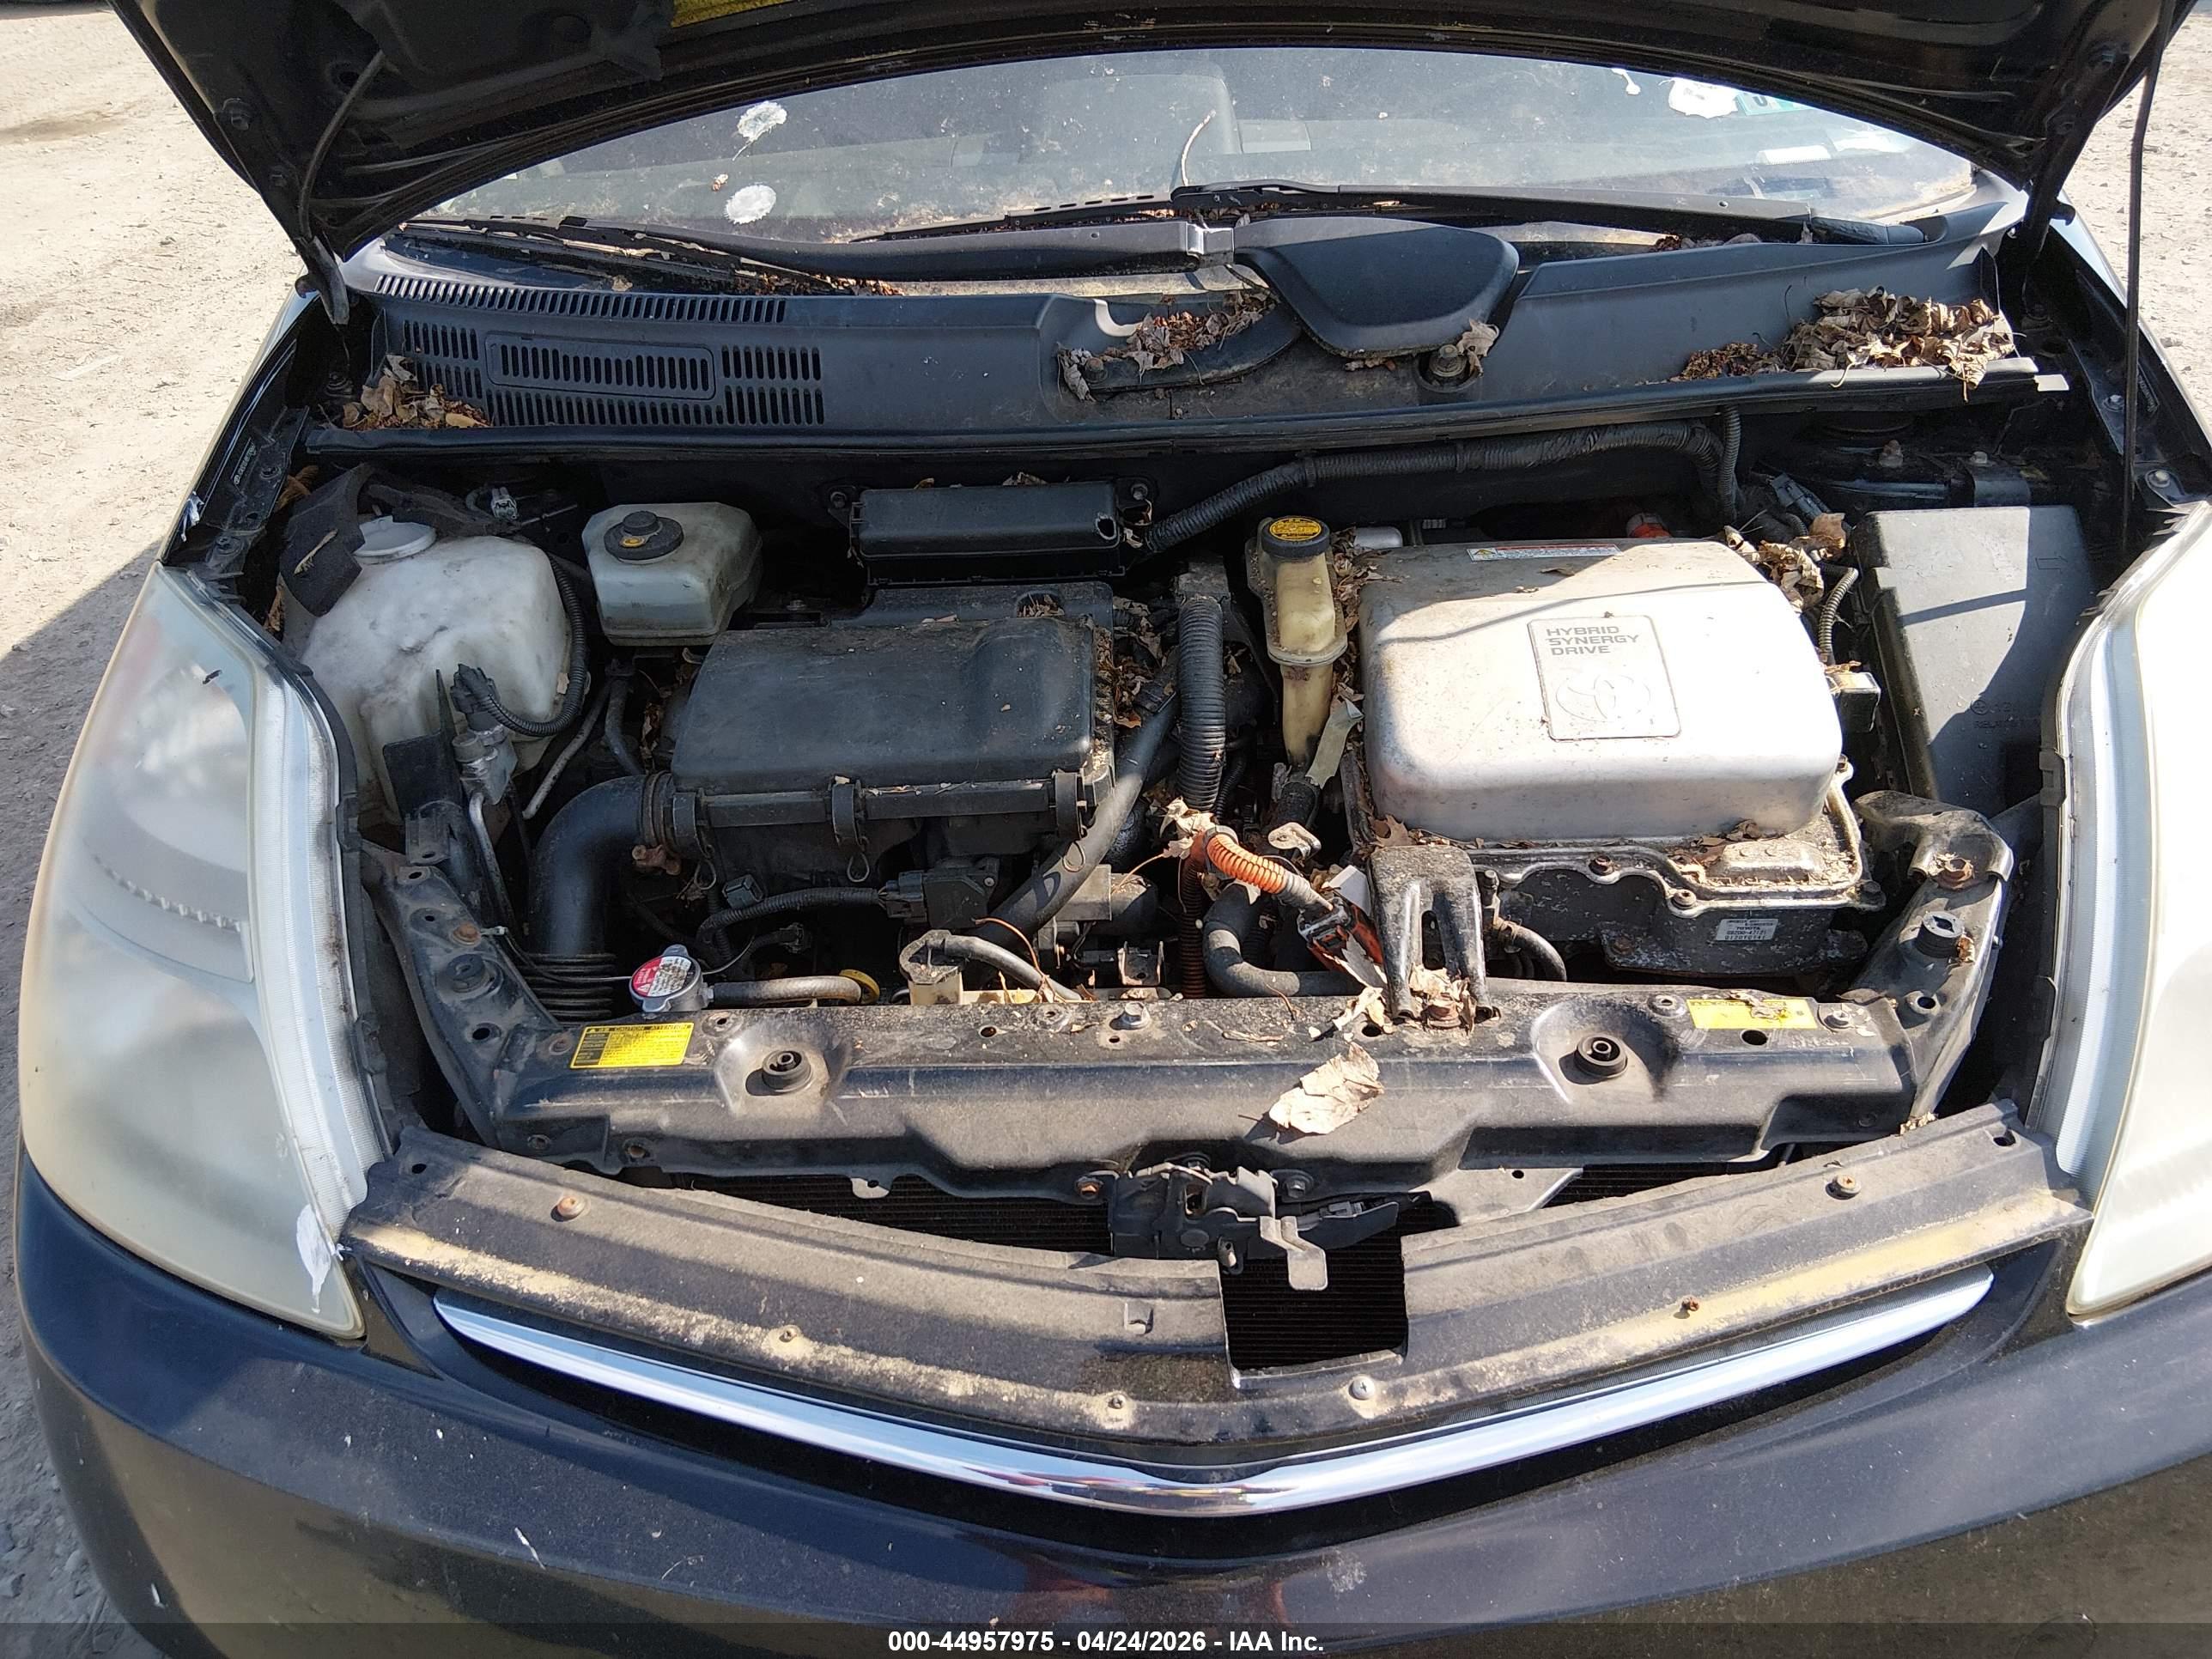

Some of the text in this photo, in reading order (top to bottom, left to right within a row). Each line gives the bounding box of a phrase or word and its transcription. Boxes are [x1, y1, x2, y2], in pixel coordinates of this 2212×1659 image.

[1547, 626, 1620, 635] HYBRID
[1547, 635, 1639, 645] SYNERGY
[1551, 646, 1611, 655] DRIVE
